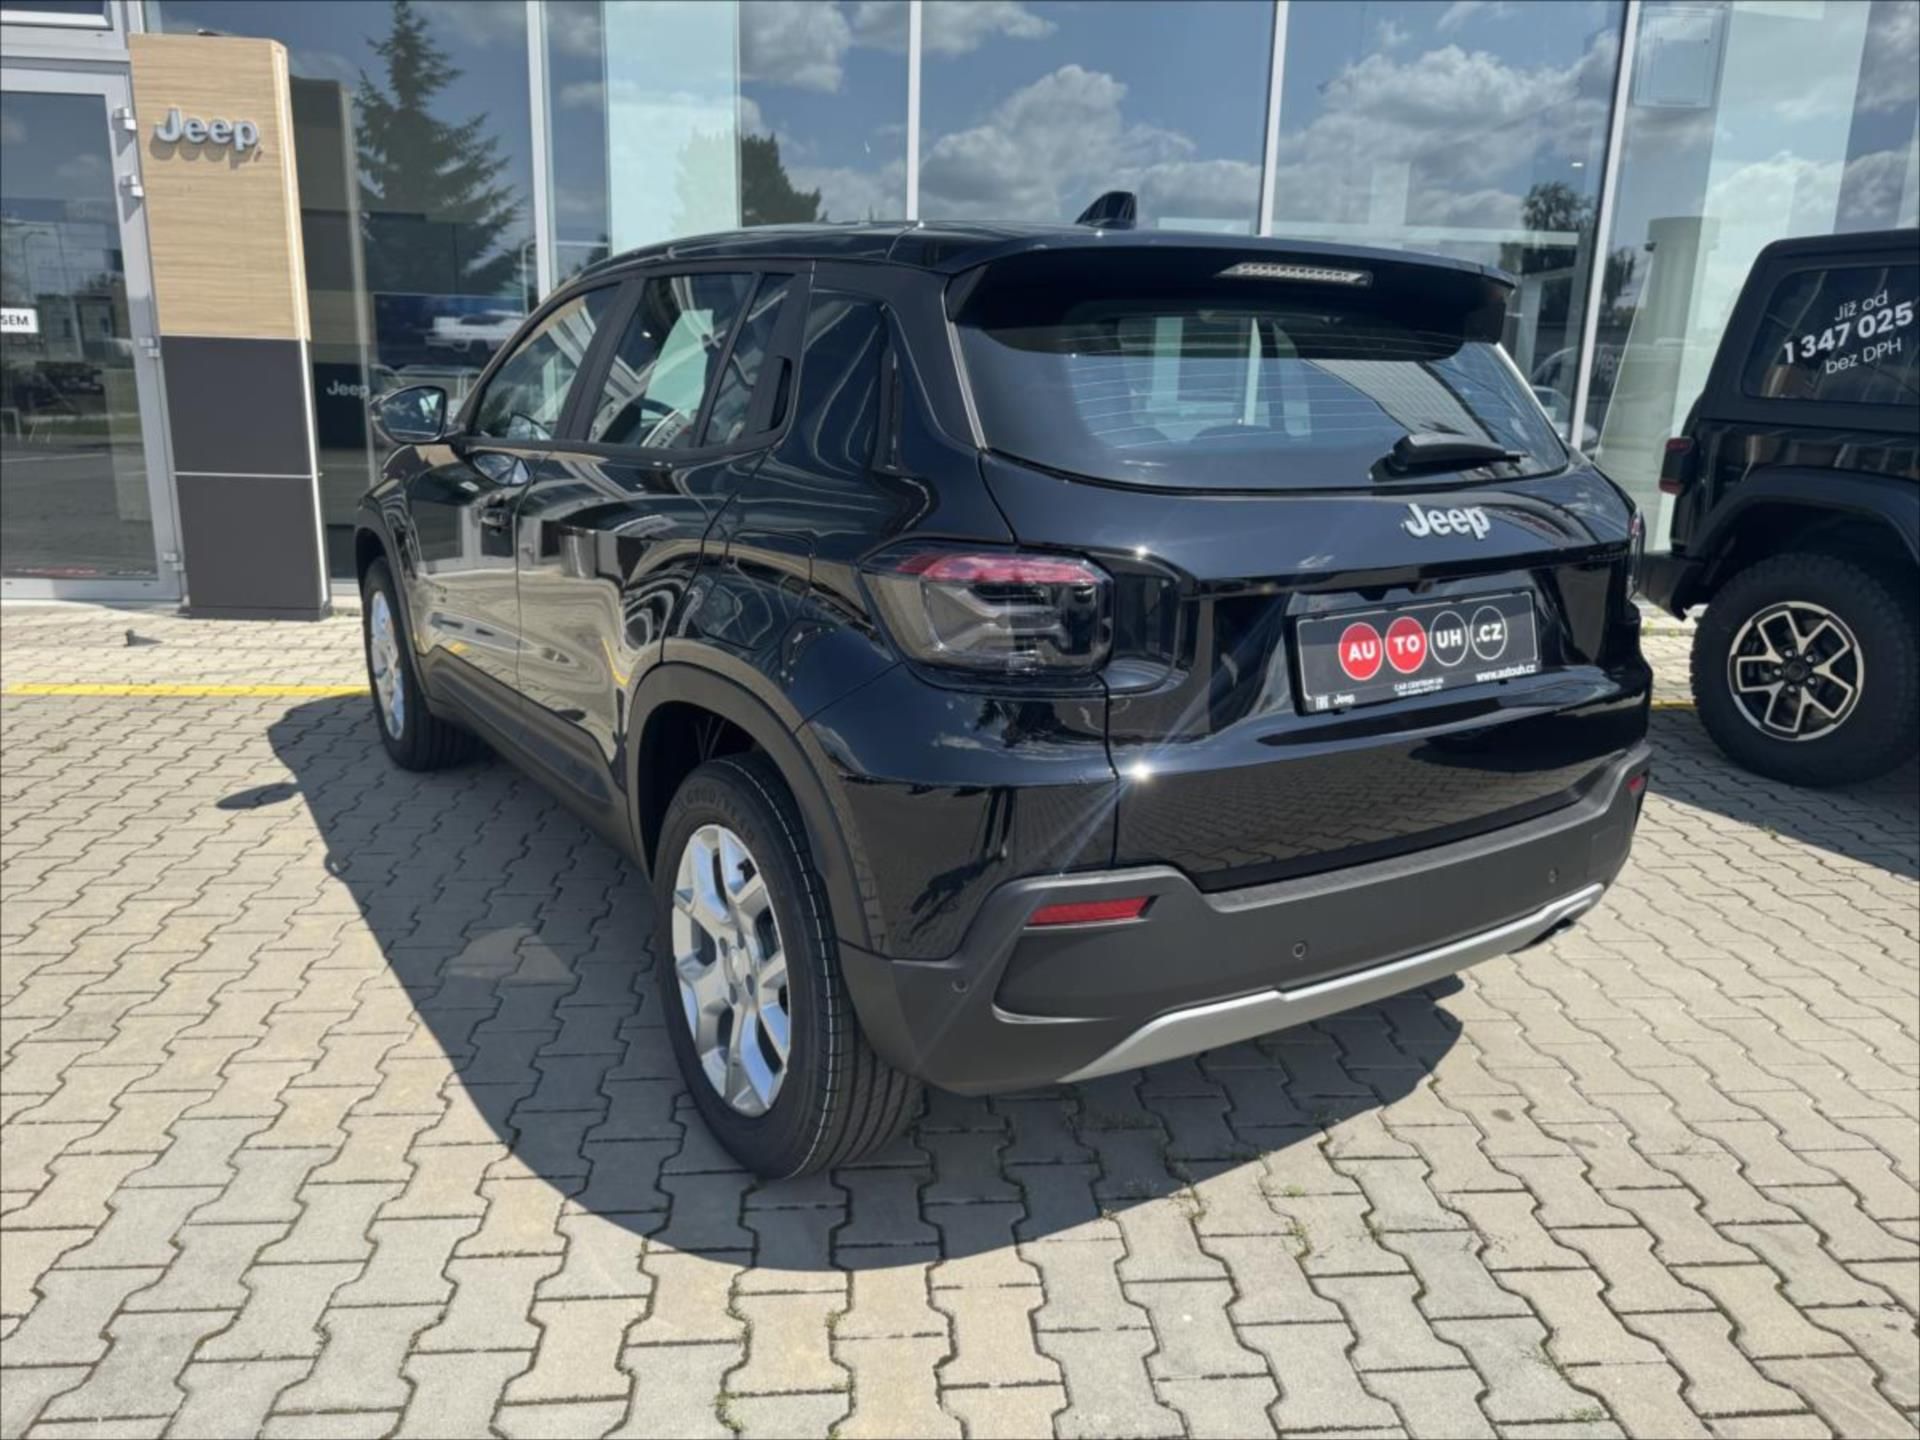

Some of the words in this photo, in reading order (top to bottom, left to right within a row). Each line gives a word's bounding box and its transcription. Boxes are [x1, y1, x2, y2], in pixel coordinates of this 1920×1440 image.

[154, 107, 258, 151] Jeep
[1834, 301, 1857, 321] Již
[1862, 289, 1888, 311] od
[1784, 341, 1794, 364] 1
[1800, 322, 1850, 358] 347
[1857, 301, 1914, 338] 025
[1826, 353, 1858, 374] bez
[1863, 337, 1902, 362] DPH
[326, 380, 370, 399] Jeep
[1405, 503, 1490, 539] Jeep
[1348, 640, 1375, 662] AU
[1393, 636, 1420, 654] TO
[1435, 629, 1462, 648] UH
[1476, 623, 1503, 643] .CZ
